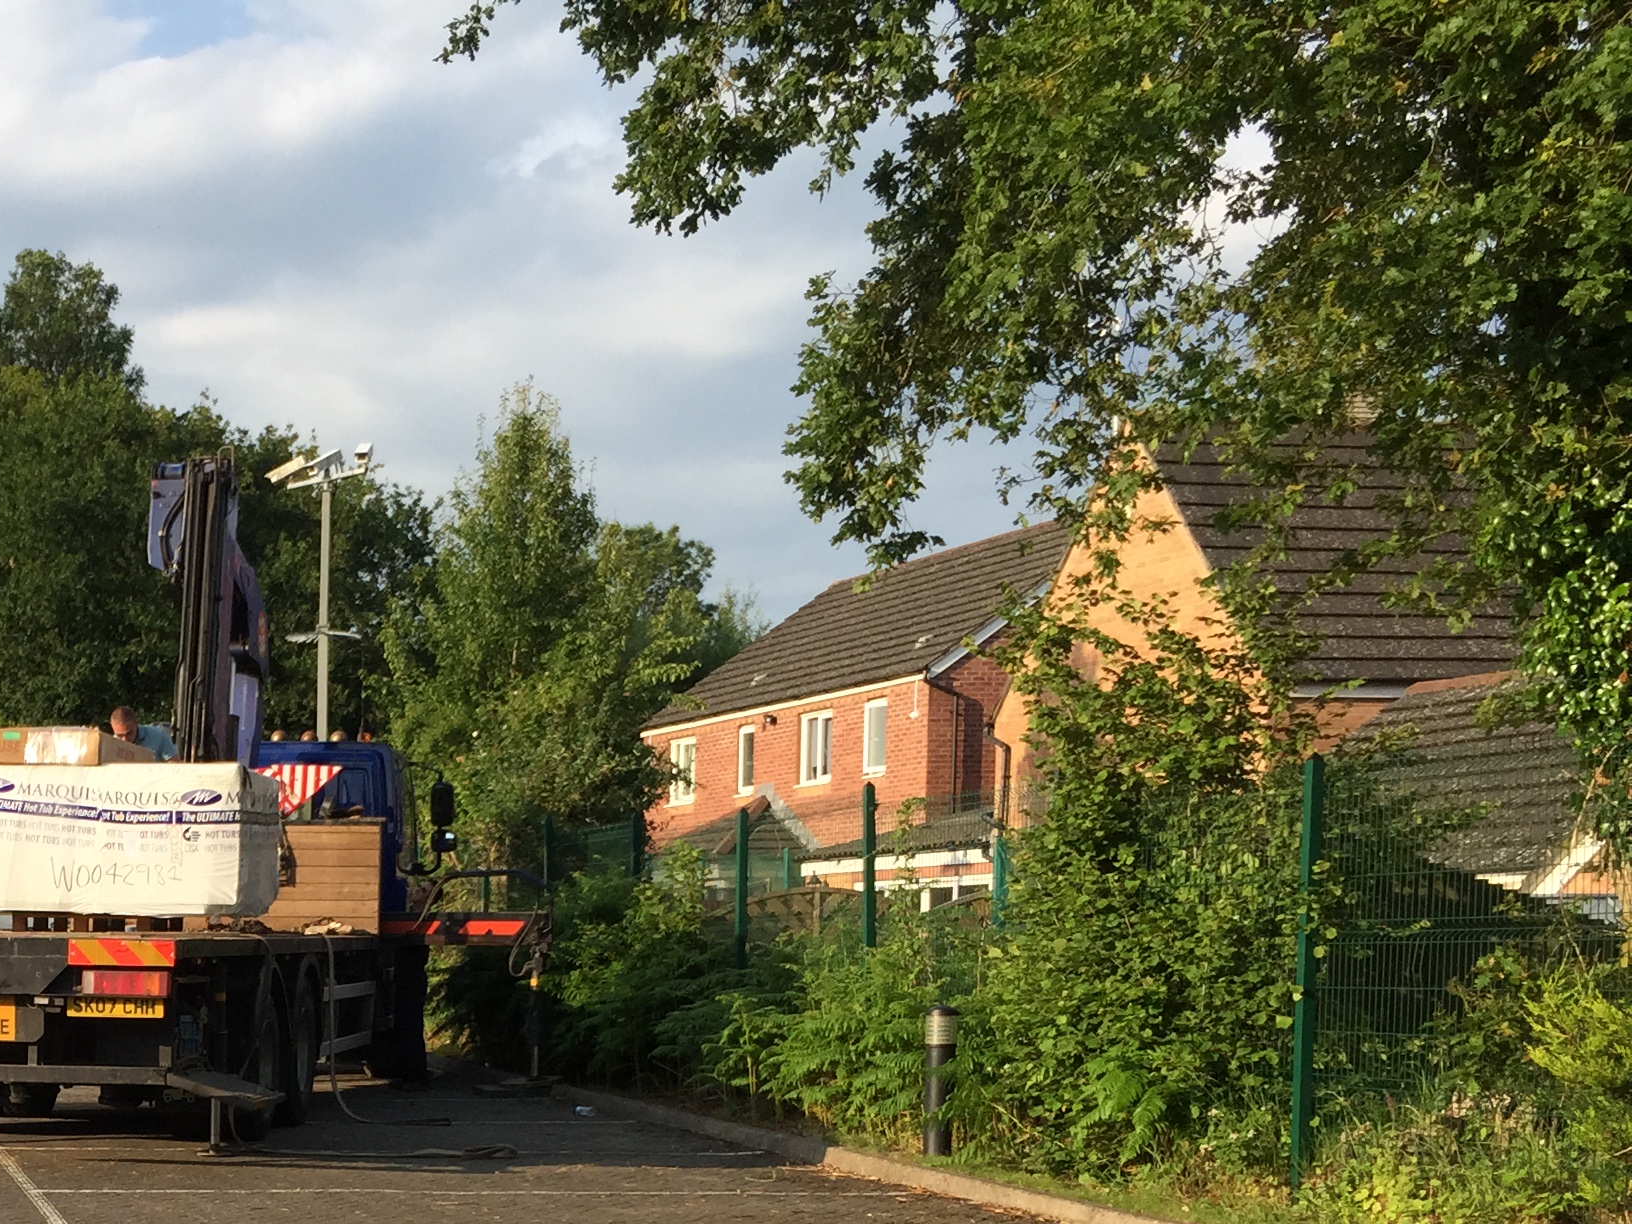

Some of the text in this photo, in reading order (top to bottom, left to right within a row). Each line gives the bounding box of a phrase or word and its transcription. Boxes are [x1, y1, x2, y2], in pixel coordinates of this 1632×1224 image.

[23, 802, 37, 813] Hot
[38, 803, 53, 814] Tub
[54, 805, 99, 818] Experience!
[111, 811, 124, 821] Tub
[126, 811, 170, 823] Experience!
[182, 811, 196, 822] The
[196, 811, 234, 823] ULTIMATE
[9, 819, 27, 829] TUBS
[28, 820, 41, 829] HOT
[44, 822, 60, 832] TUBS
[61, 825, 76, 833] HOT
[77, 825, 96, 835] TUBS
[25, 834, 40, 843] HOT
[42, 835, 60, 845] TUBS
[63, 838, 77, 846] HOT
[150, 831, 168, 839] TUBS
[205, 830, 240, 839] HOT TUBS
[205, 844, 237, 852] HOT TUBS
[73, 998, 116, 1013] SK07
